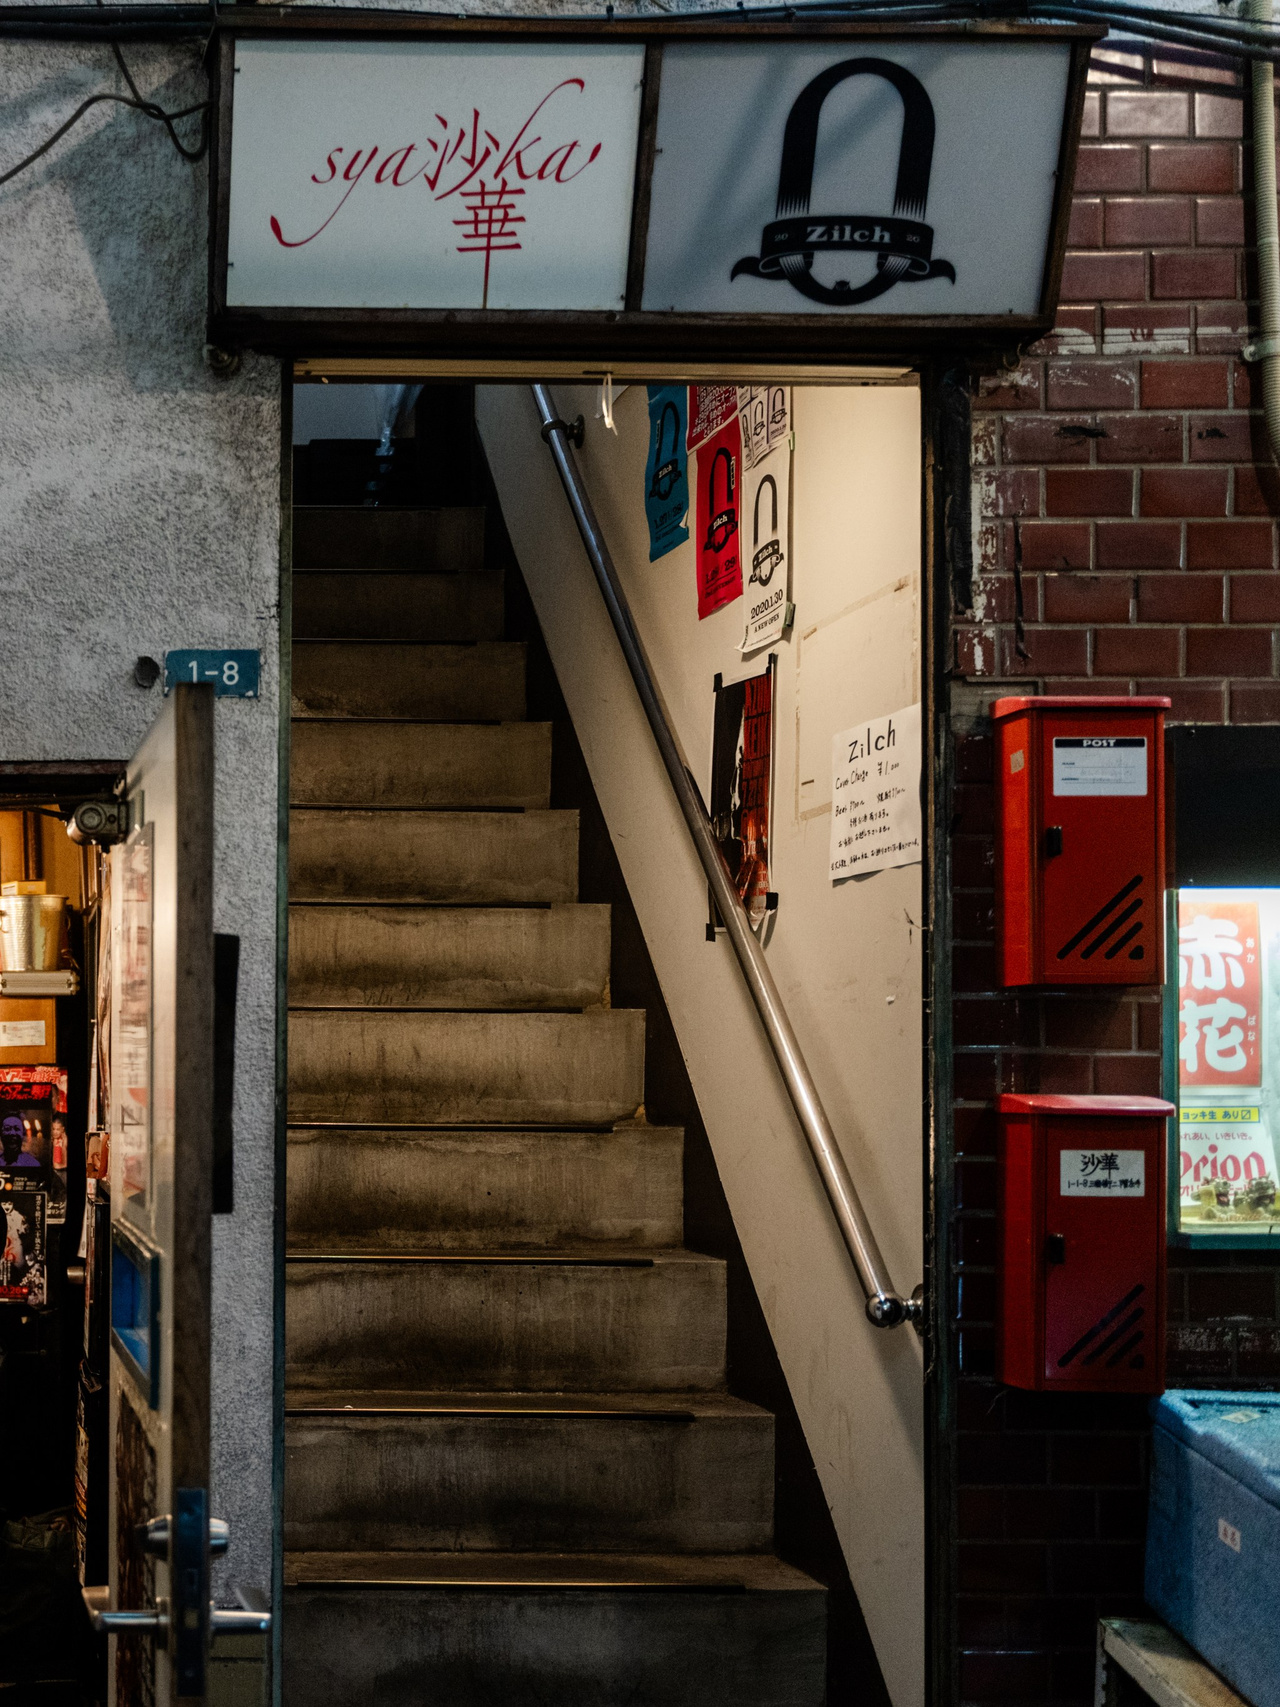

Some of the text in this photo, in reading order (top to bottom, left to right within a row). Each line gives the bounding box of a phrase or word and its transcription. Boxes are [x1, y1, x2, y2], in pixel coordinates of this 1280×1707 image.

[805, 225, 892, 244] Zilch
[188, 660, 240, 686] 1-8
[848, 719, 896, 764] Zilch
[1082, 739, 1116, 747] POST
[1179, 915, 1248, 1073] 赤花
[1080, 1152, 1120, 1180] 沙華
